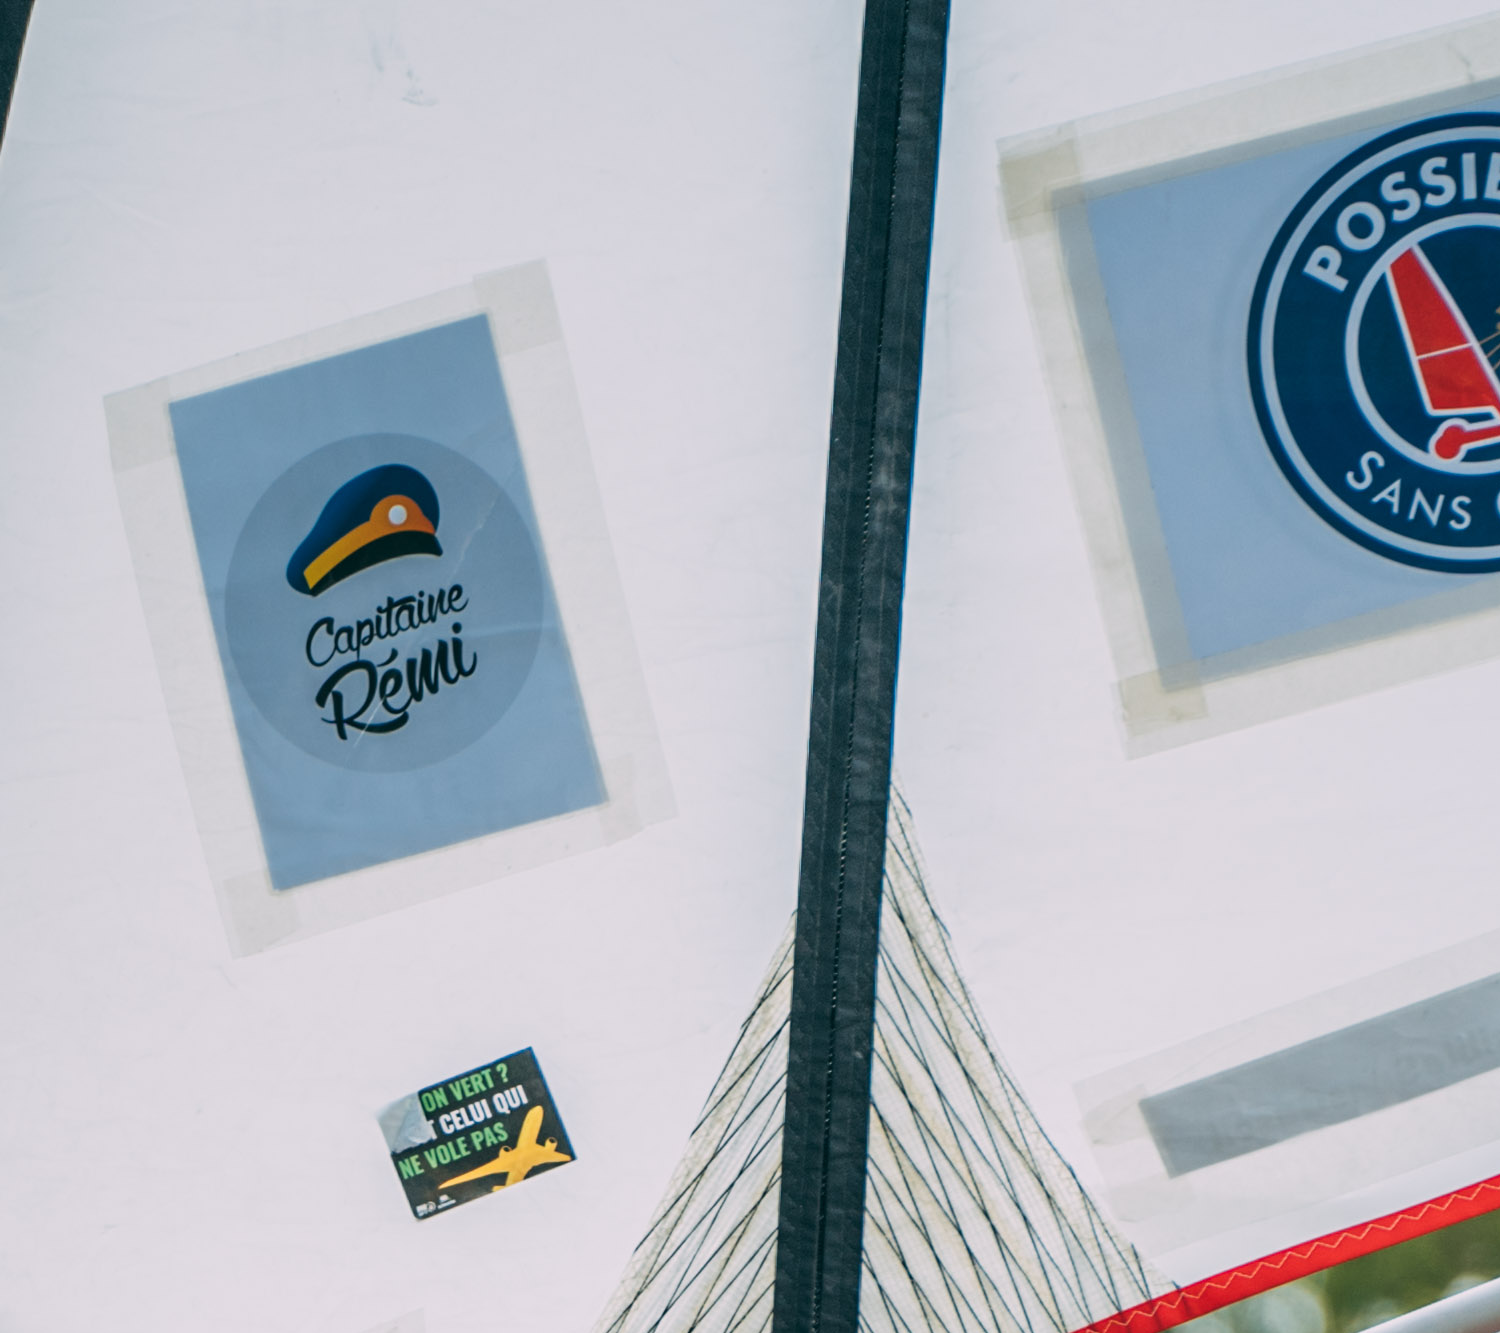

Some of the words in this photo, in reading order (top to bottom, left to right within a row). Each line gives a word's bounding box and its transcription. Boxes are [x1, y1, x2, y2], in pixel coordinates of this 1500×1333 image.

[1346, 451, 1472, 530] SANS
[305, 584, 470, 667] Capitaine
[315, 622, 478, 741] Rémi
[439, 1098, 493, 1135] CELUI
[492, 1085, 528, 1114] QUI
[449, 1068, 495, 1100] VERT
[495, 1063, 509, 1083] ?
[398, 1155, 425, 1180] NE
[424, 1136, 471, 1169] VOLE
[470, 1122, 509, 1151] PAS
